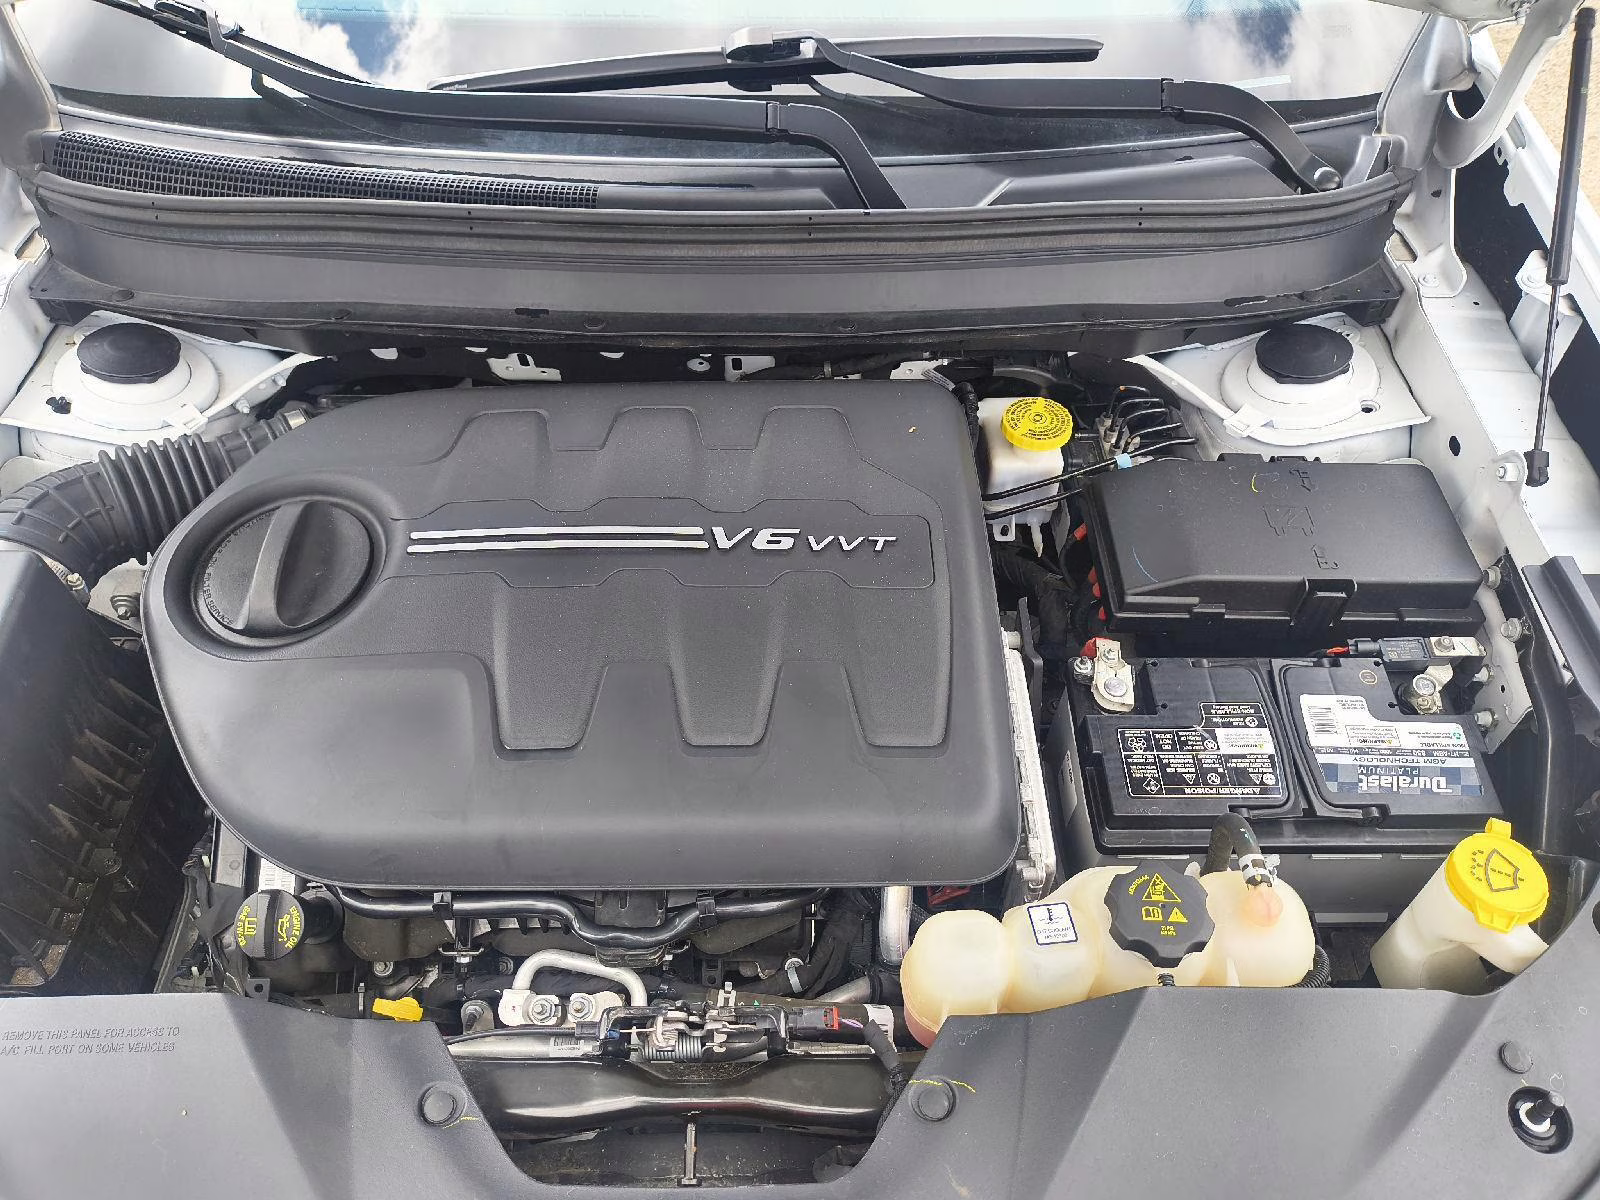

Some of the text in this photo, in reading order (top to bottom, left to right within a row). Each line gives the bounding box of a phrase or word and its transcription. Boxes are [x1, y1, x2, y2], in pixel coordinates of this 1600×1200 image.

[711, 526, 898, 552] V6 VVT
[208, 600, 234, 625] SERVICE
[1357, 766, 1419, 775] PLATINUM
[1357, 775, 1453, 794] Duralast
[284, 905, 301, 949] ENGINE OIL
[47, 1030, 69, 1040] THIS
[71, 1028, 102, 1039] PANEL
[104, 1028, 125, 1039] FOR
[167, 1026, 180, 1037] TO
[0, 1045, 20, 1056] A/C
[48, 1044, 75, 1055] PORT
[78, 1043, 93, 1054] ON
[95, 1043, 126, 1054] SOME
[128, 1041, 175, 1053] VEHICLES
